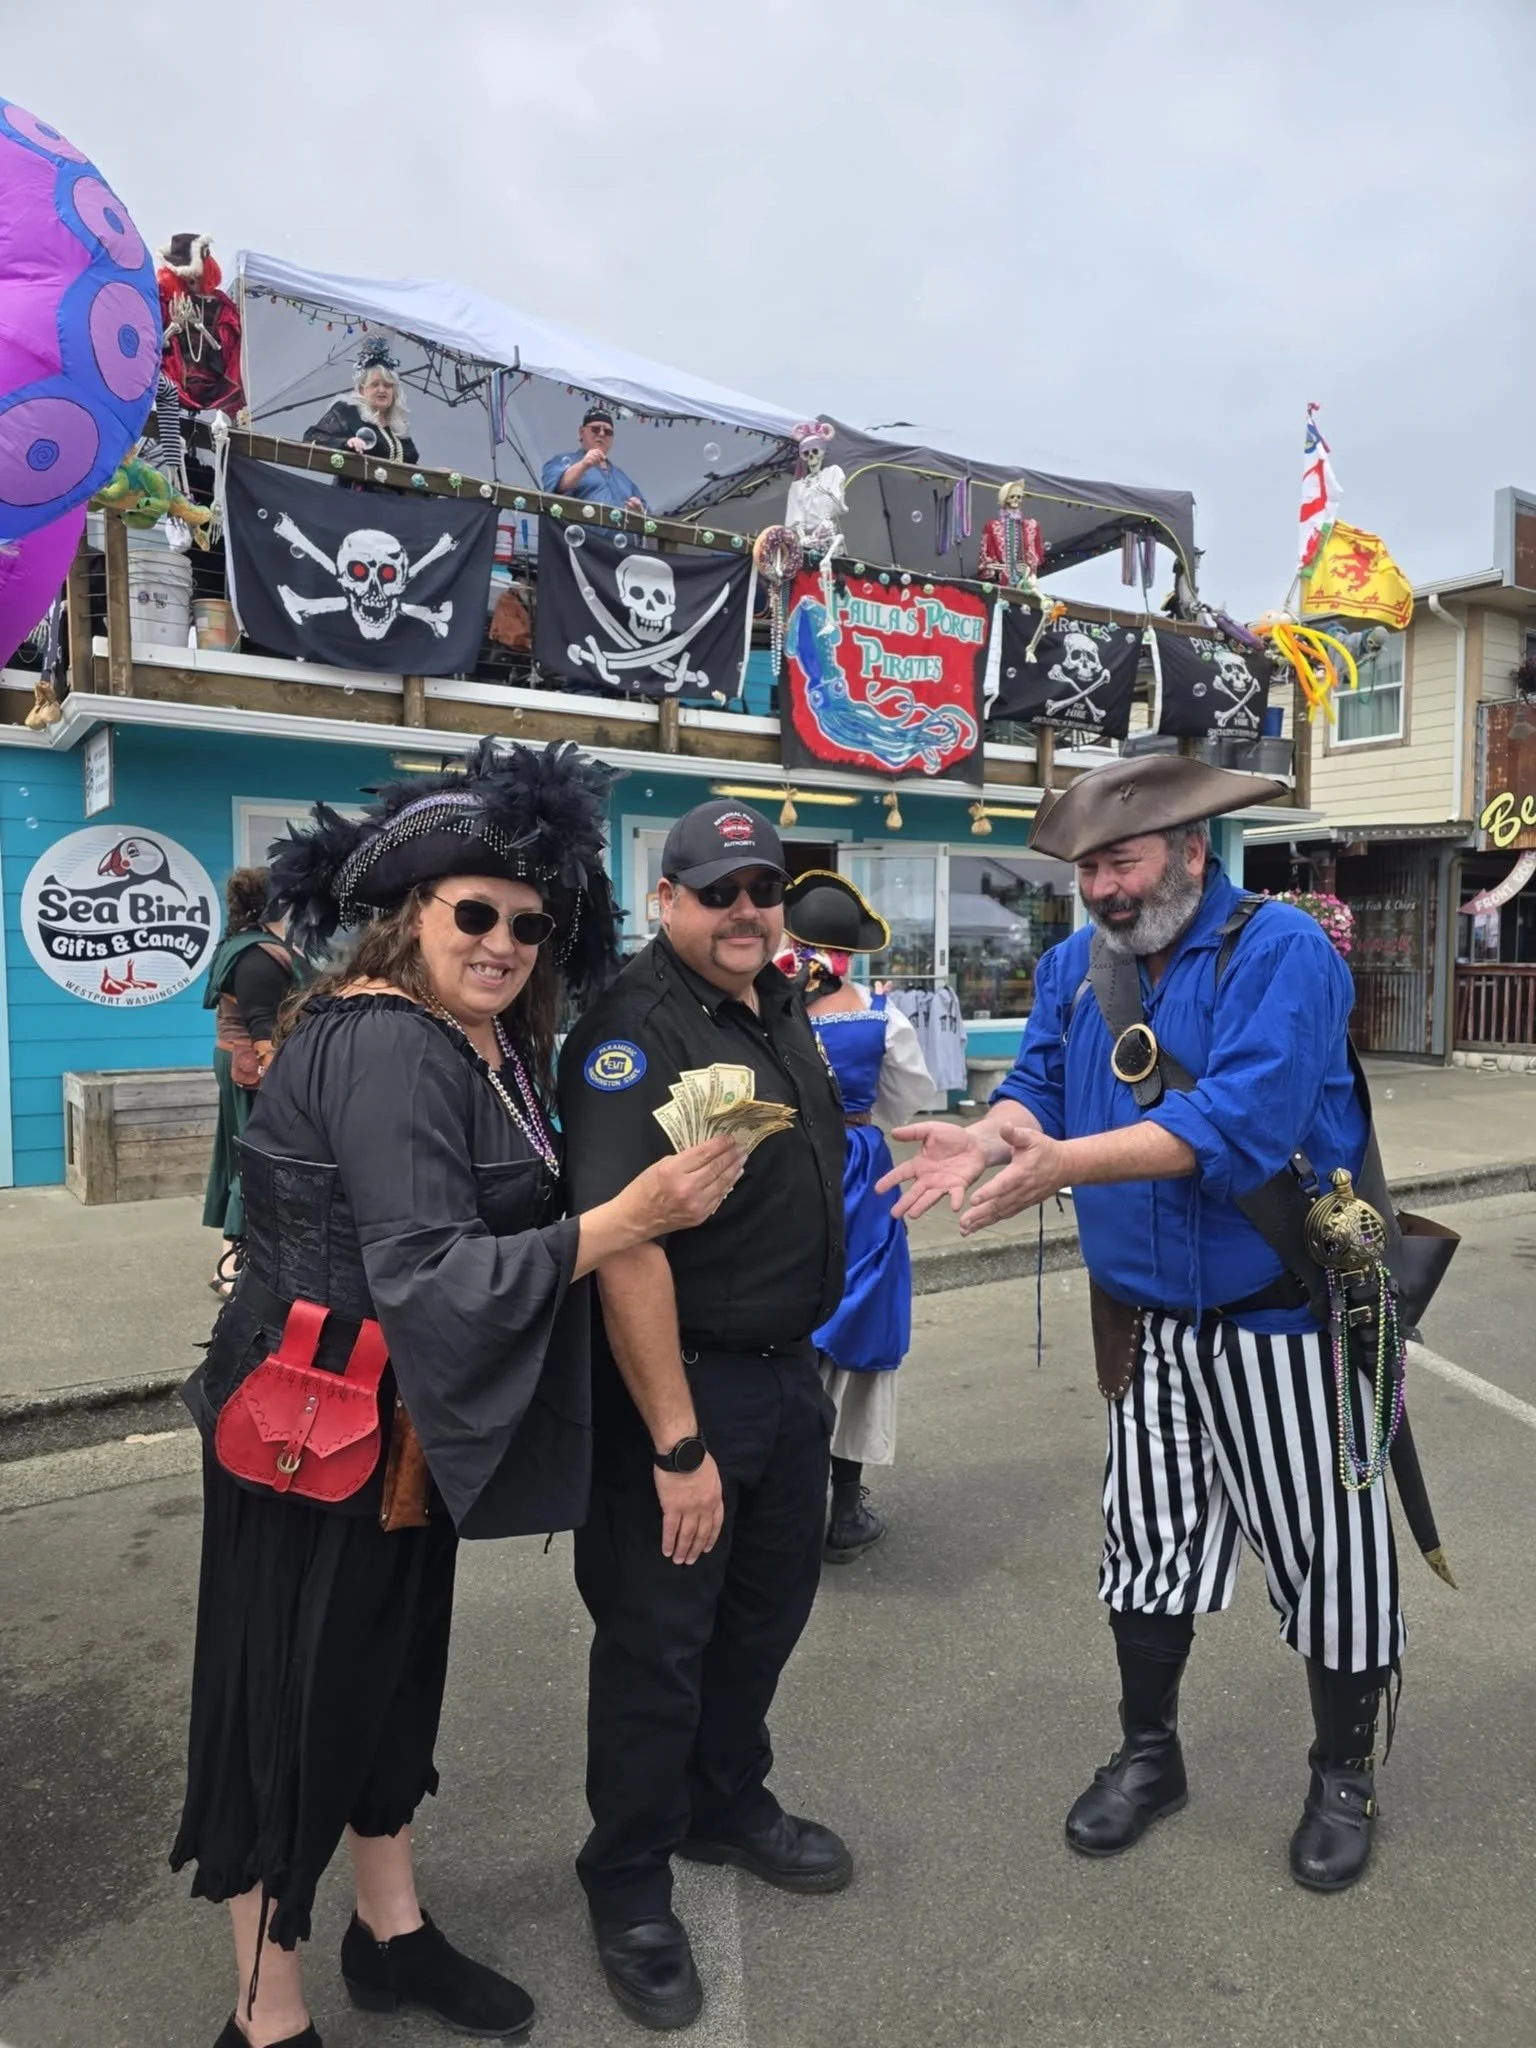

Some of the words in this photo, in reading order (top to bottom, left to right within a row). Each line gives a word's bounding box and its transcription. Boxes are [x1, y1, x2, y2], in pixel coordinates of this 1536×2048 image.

[852, 631, 943, 684] PIRATES
[723, 840, 756, 849] AUTHORITY
[38, 888, 119, 924] Sea
[128, 892, 211, 927] Bird
[1474, 883, 1515, 912] FRONT
[52, 935, 108, 958] Gifts
[111, 934, 131, 953] &
[133, 930, 201, 960] Candy
[64, 979, 121, 1006] WESTPORT
[126, 976, 191, 1006] WASHINGTON
[598, 1043, 638, 1057] PARAMEDIC
[607, 1060, 626, 1072] EMT
